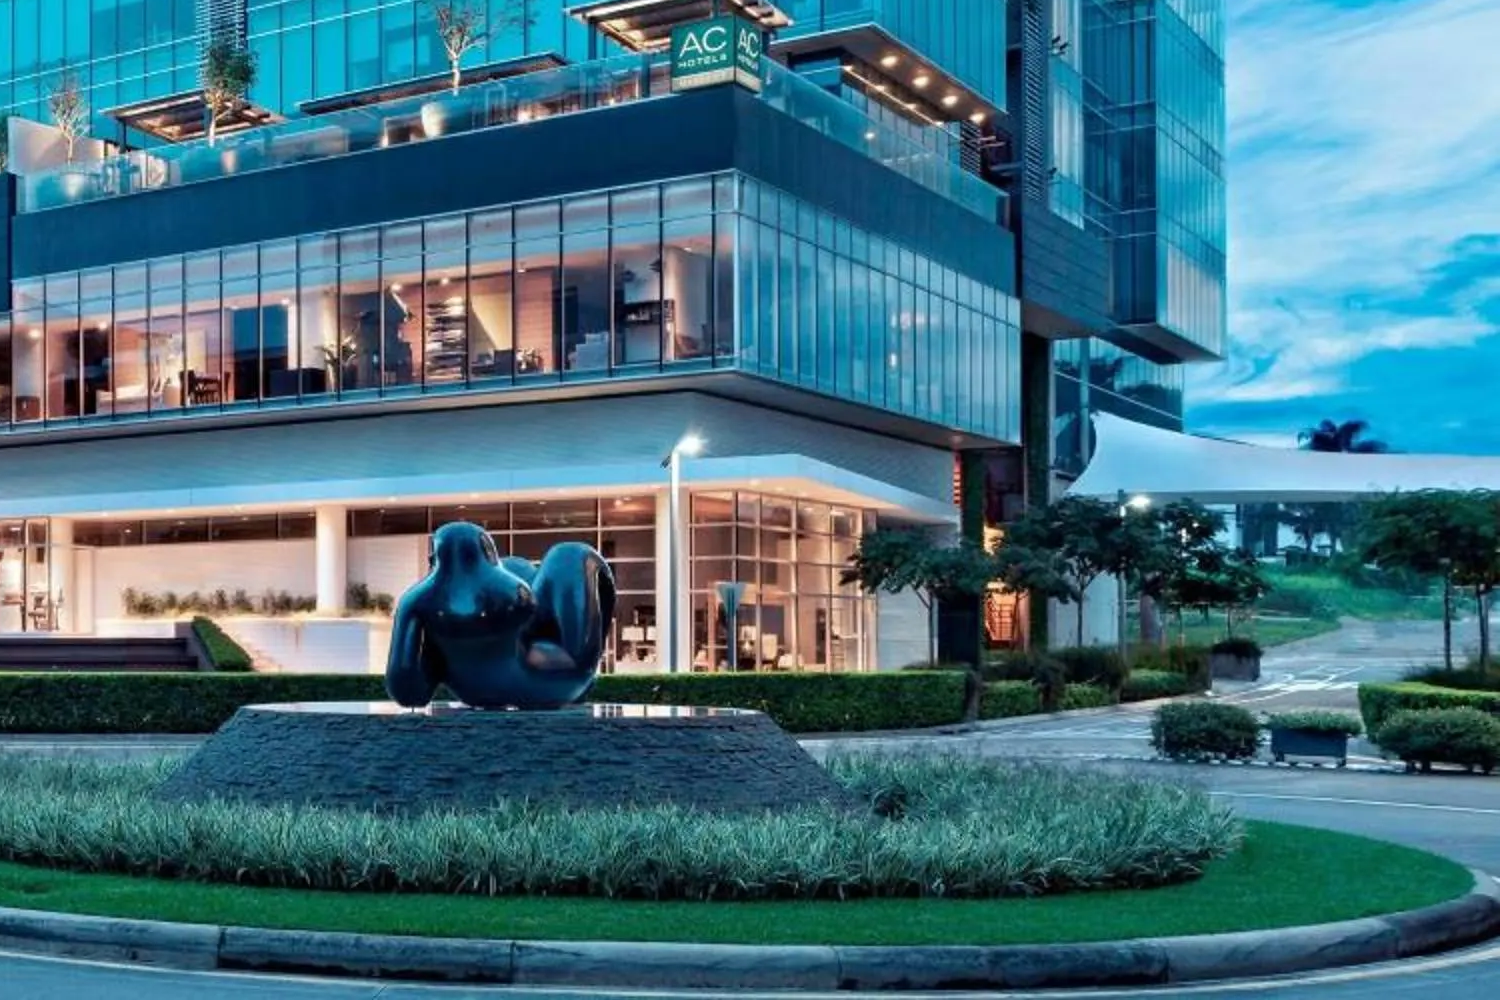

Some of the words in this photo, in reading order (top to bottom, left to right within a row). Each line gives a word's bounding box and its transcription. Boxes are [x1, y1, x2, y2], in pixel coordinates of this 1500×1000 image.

[679, 26, 726, 58] AC
[737, 28, 758, 58] AC
[677, 53, 727, 68] HOTELS
